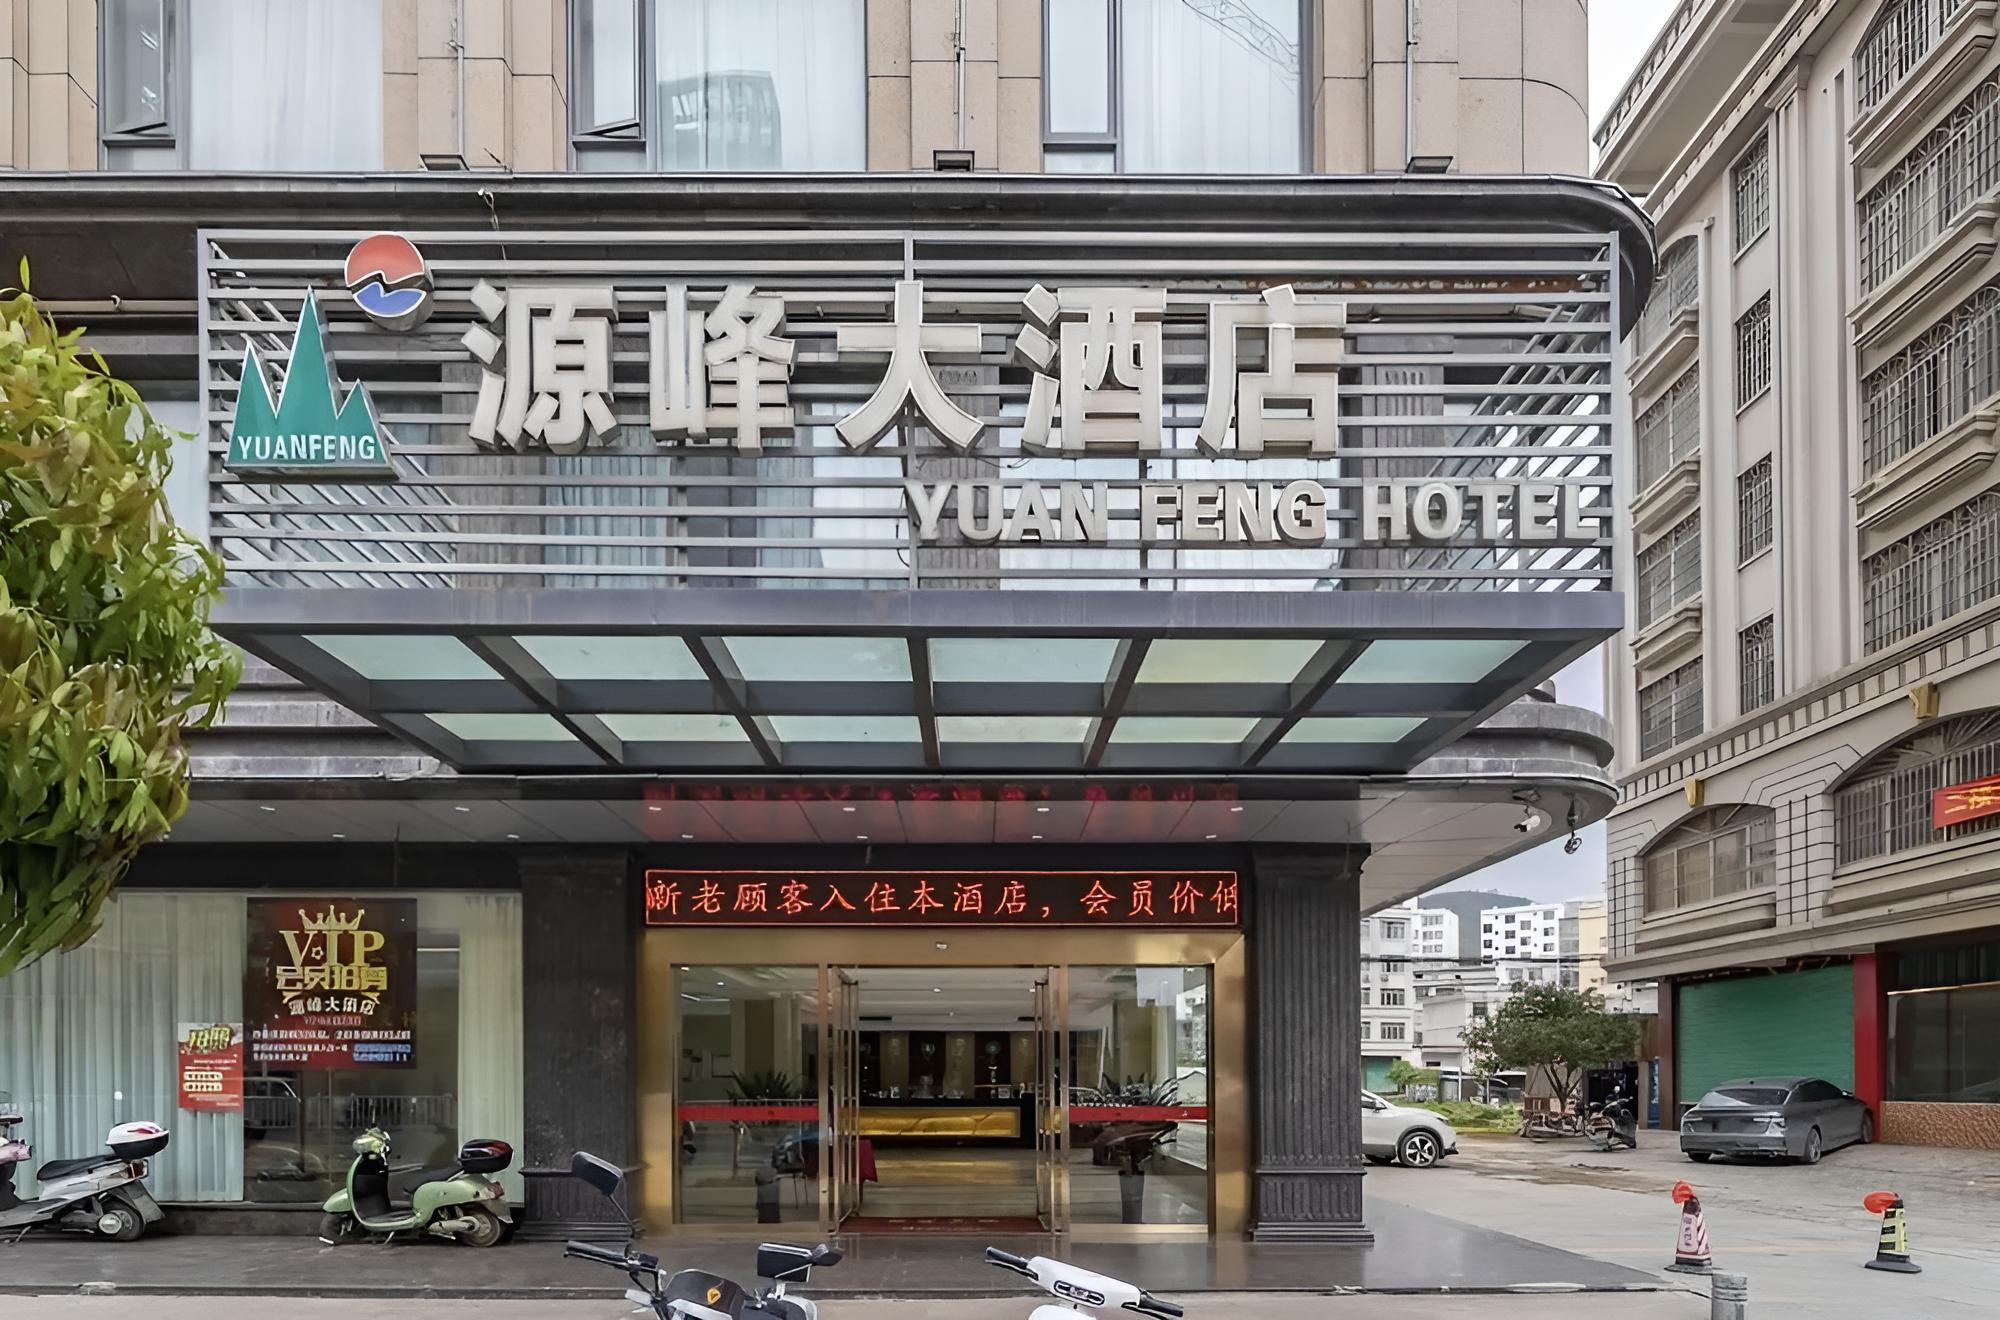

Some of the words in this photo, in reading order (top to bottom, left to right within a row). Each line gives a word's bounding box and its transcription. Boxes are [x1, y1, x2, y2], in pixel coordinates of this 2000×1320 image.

[460, 279, 1347, 455] 源峰大酒店
[237, 434, 376, 461] YUANFENG
[902, 479, 1108, 543] YUAN
[1140, 479, 1329, 544] FENG
[1361, 480, 1602, 543] HOTEL
[279, 930, 385, 967] VIP
